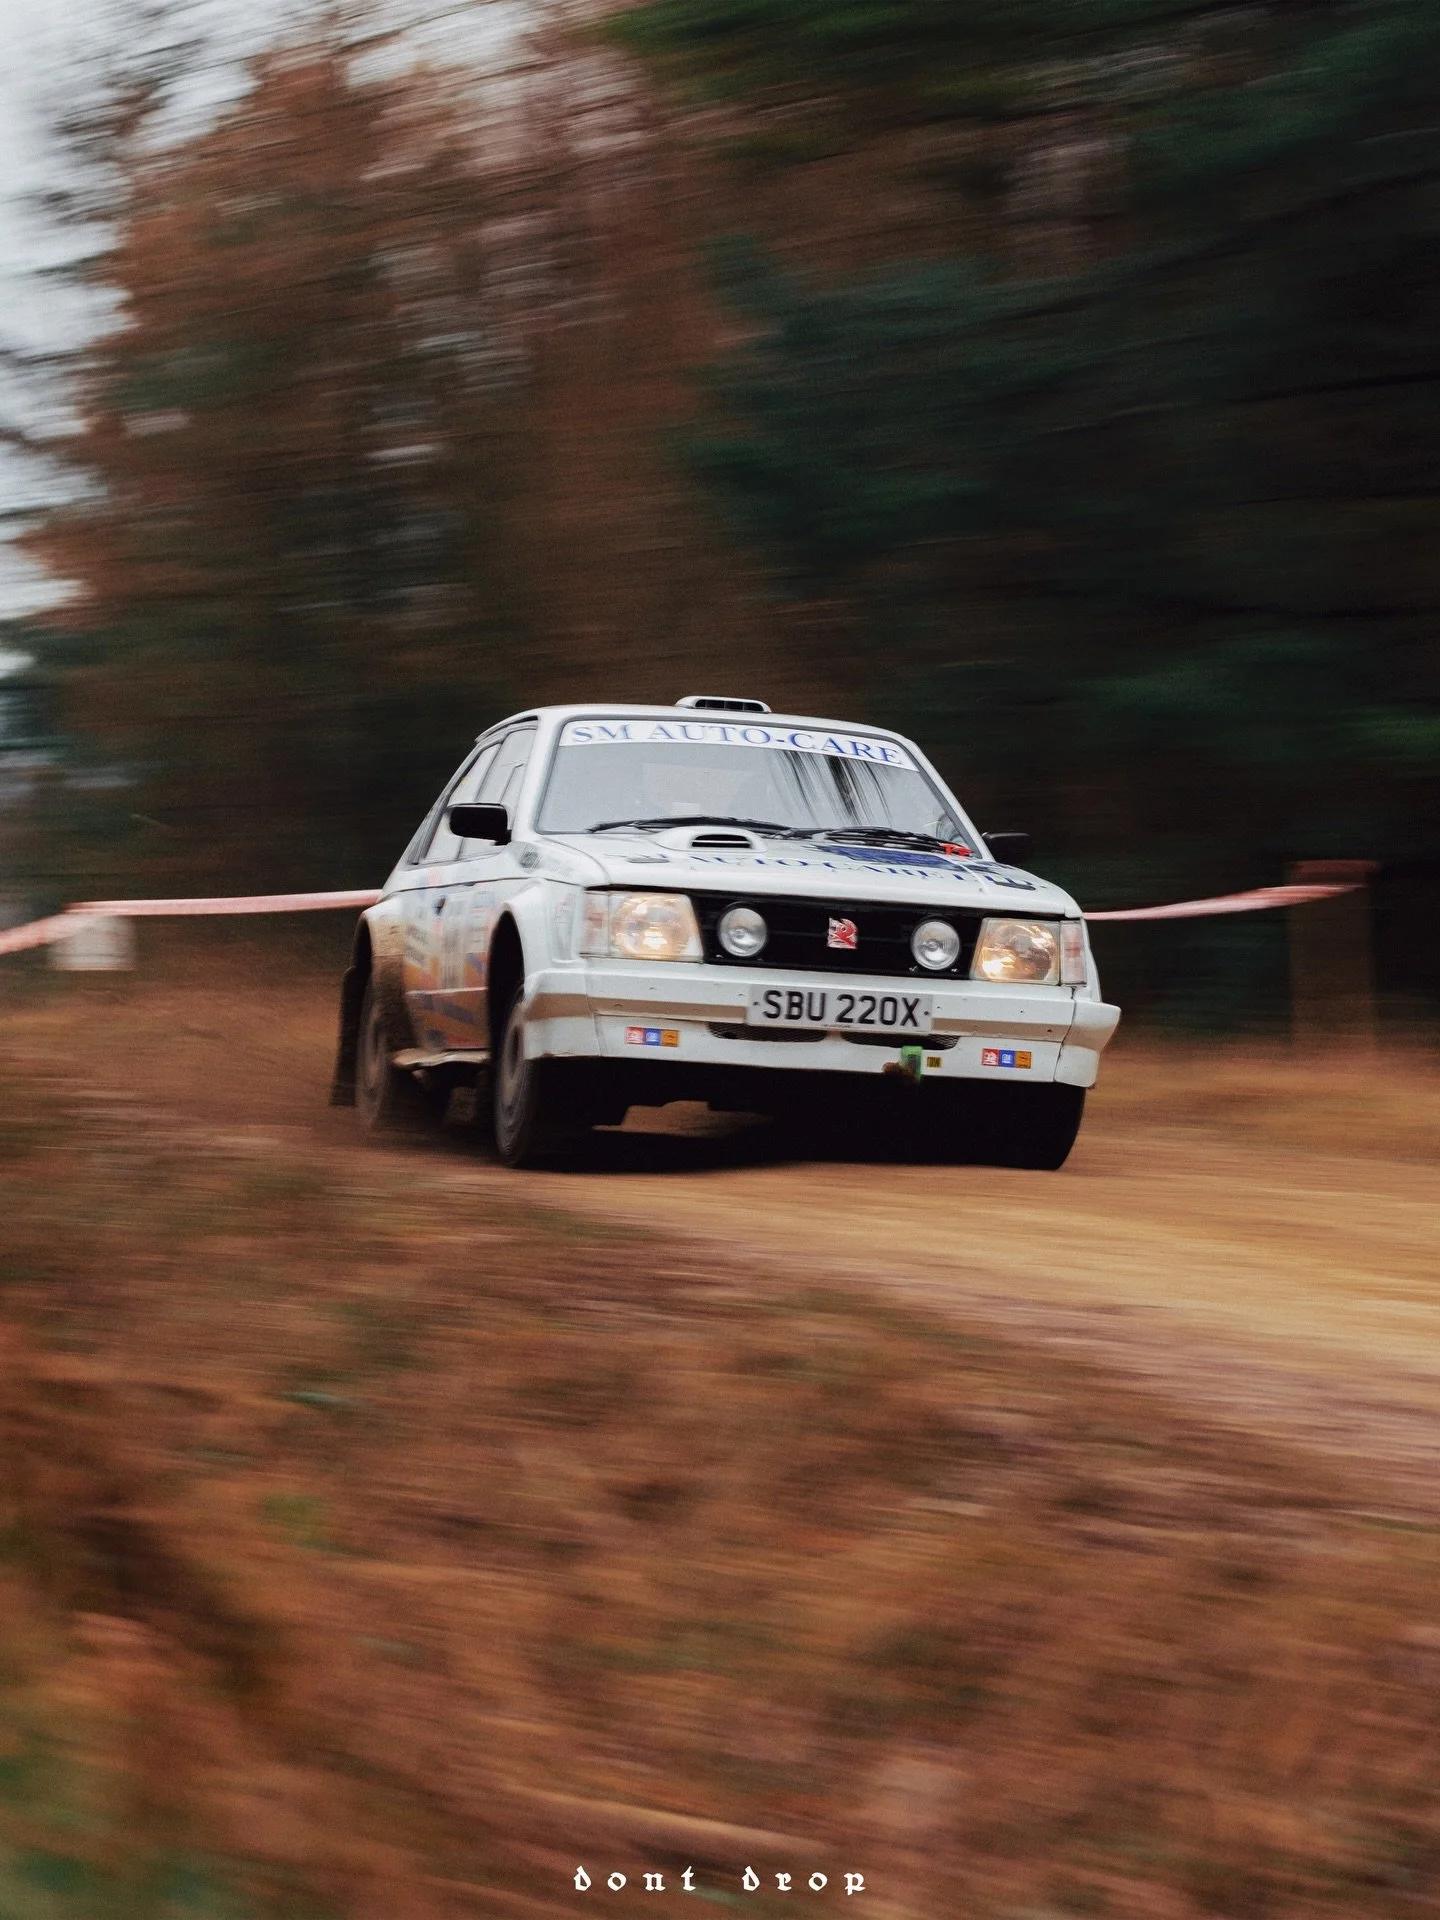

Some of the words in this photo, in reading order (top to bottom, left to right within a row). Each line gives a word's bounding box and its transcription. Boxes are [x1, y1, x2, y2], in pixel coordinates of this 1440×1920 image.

[572, 724, 633, 742] SM
[648, 723, 902, 765] AUTO-CARE
[763, 989, 826, 1021] SBU
[835, 994, 920, 1027] 220X
